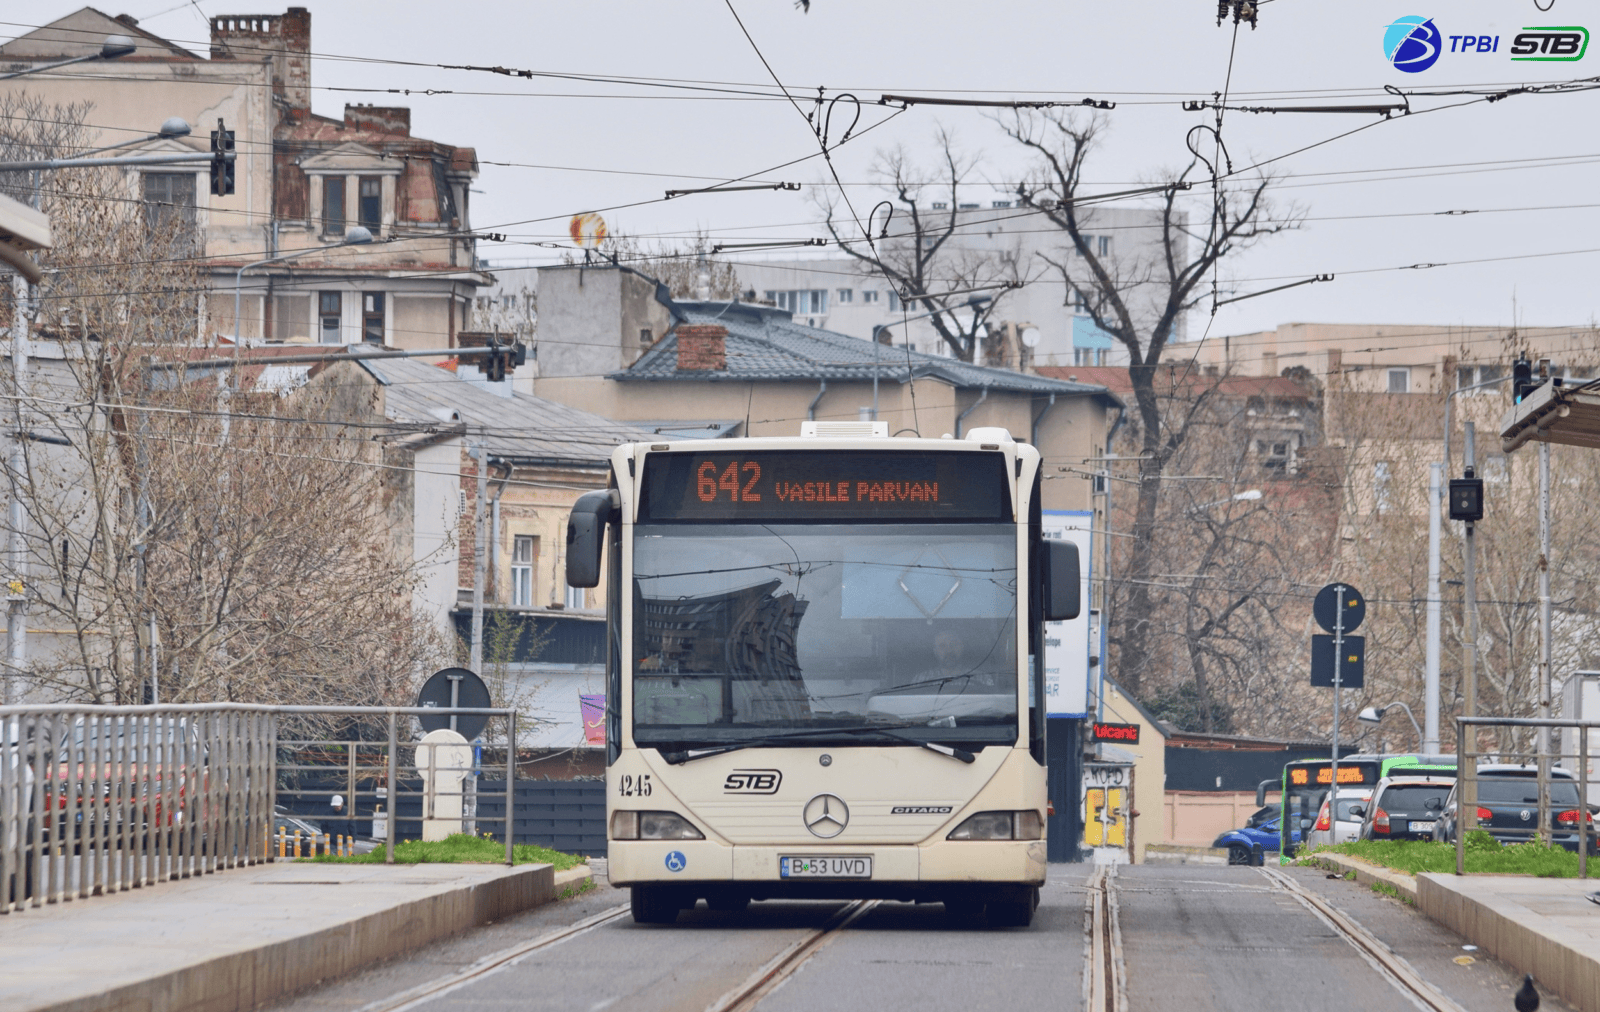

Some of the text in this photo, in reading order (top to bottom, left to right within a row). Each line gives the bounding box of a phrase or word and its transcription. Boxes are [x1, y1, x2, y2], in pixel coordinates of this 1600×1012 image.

[697, 461, 939, 502] 642 VASILE PARVAN
[618, 774, 653, 797] 4245
[723, 773, 777, 790] STB
[893, 806, 951, 814] CITARO
[792, 859, 866, 875] B 53 UVD
